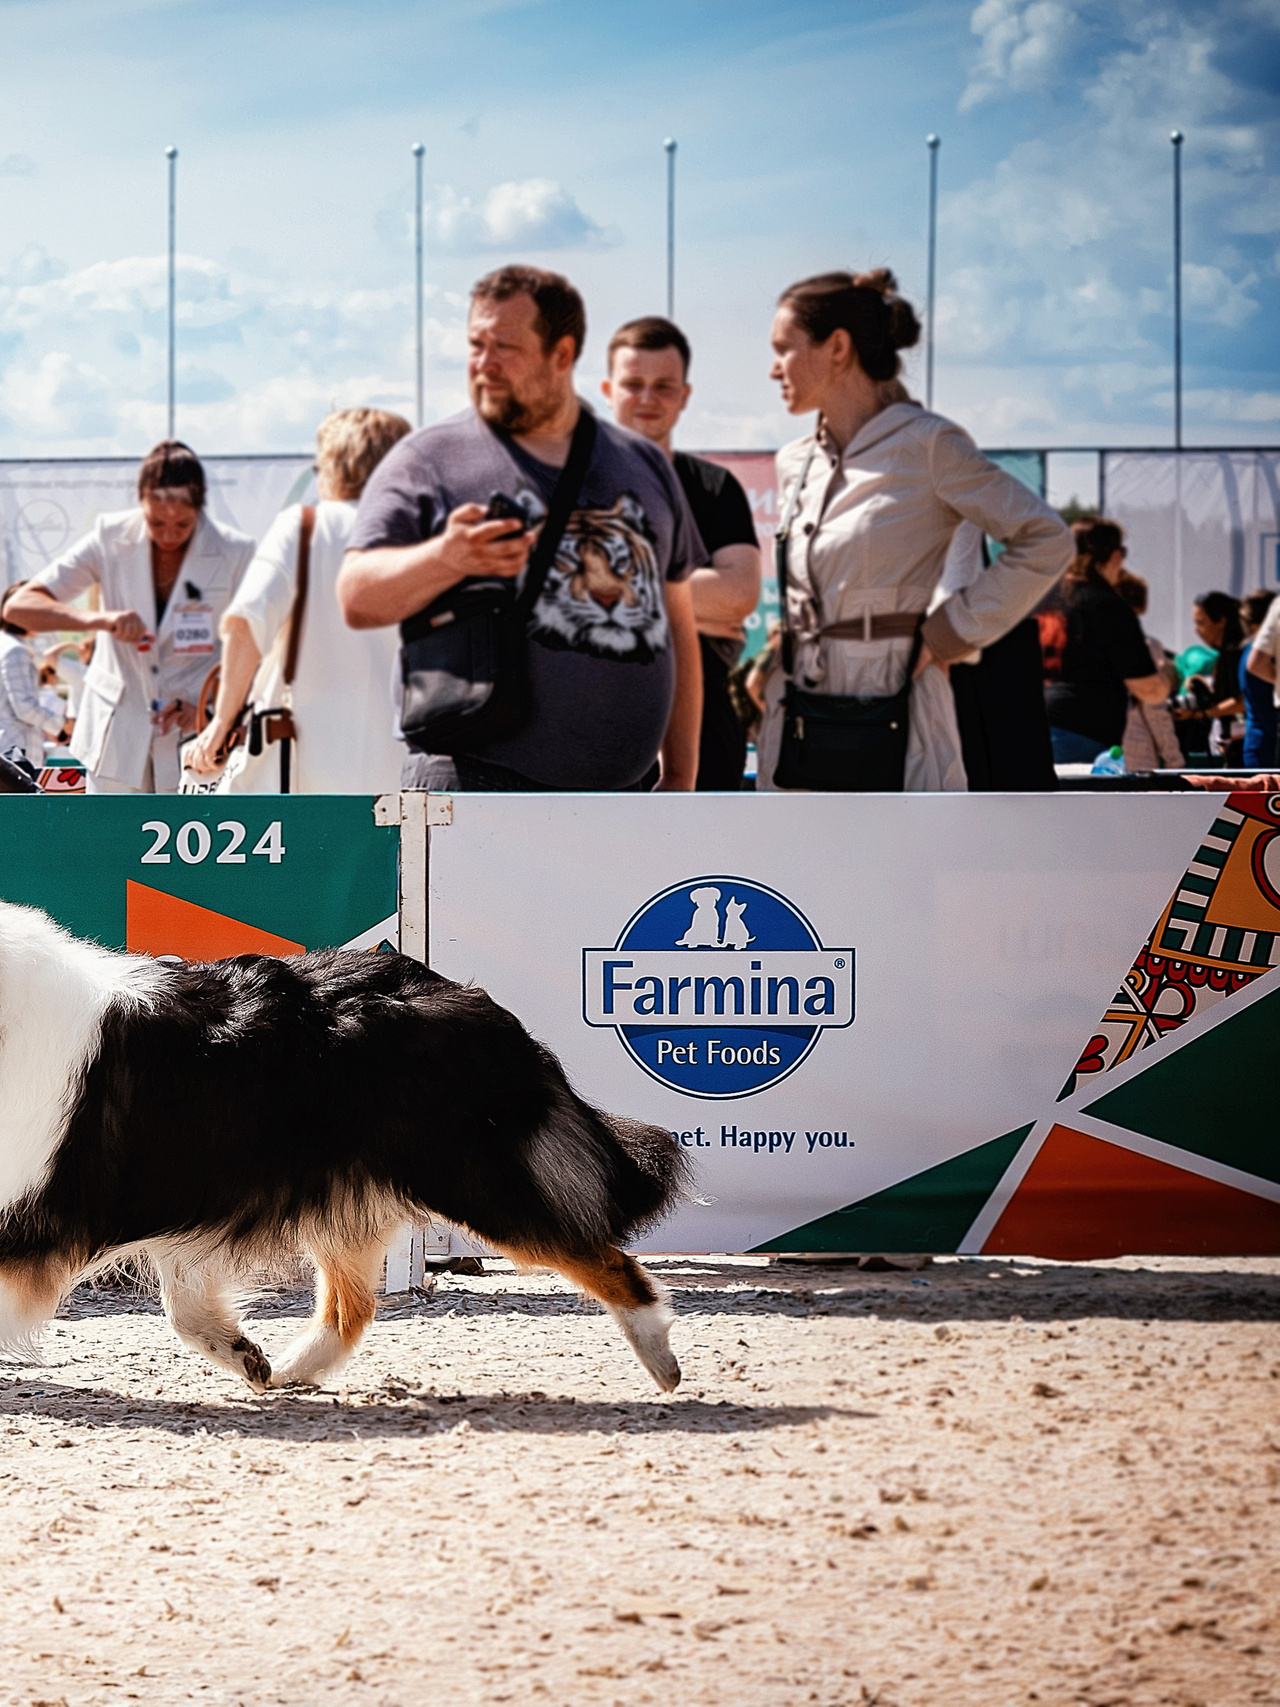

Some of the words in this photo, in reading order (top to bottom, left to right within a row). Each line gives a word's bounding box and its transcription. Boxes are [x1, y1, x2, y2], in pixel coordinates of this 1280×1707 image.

[176, 627, 210, 641] 0280
[140, 820, 287, 865] 2024
[656, 1039, 699, 1065] Pet
[707, 1039, 782, 1066] Foods
[720, 1125, 797, 1154] Happy
[805, 1130, 856, 1154] you.
